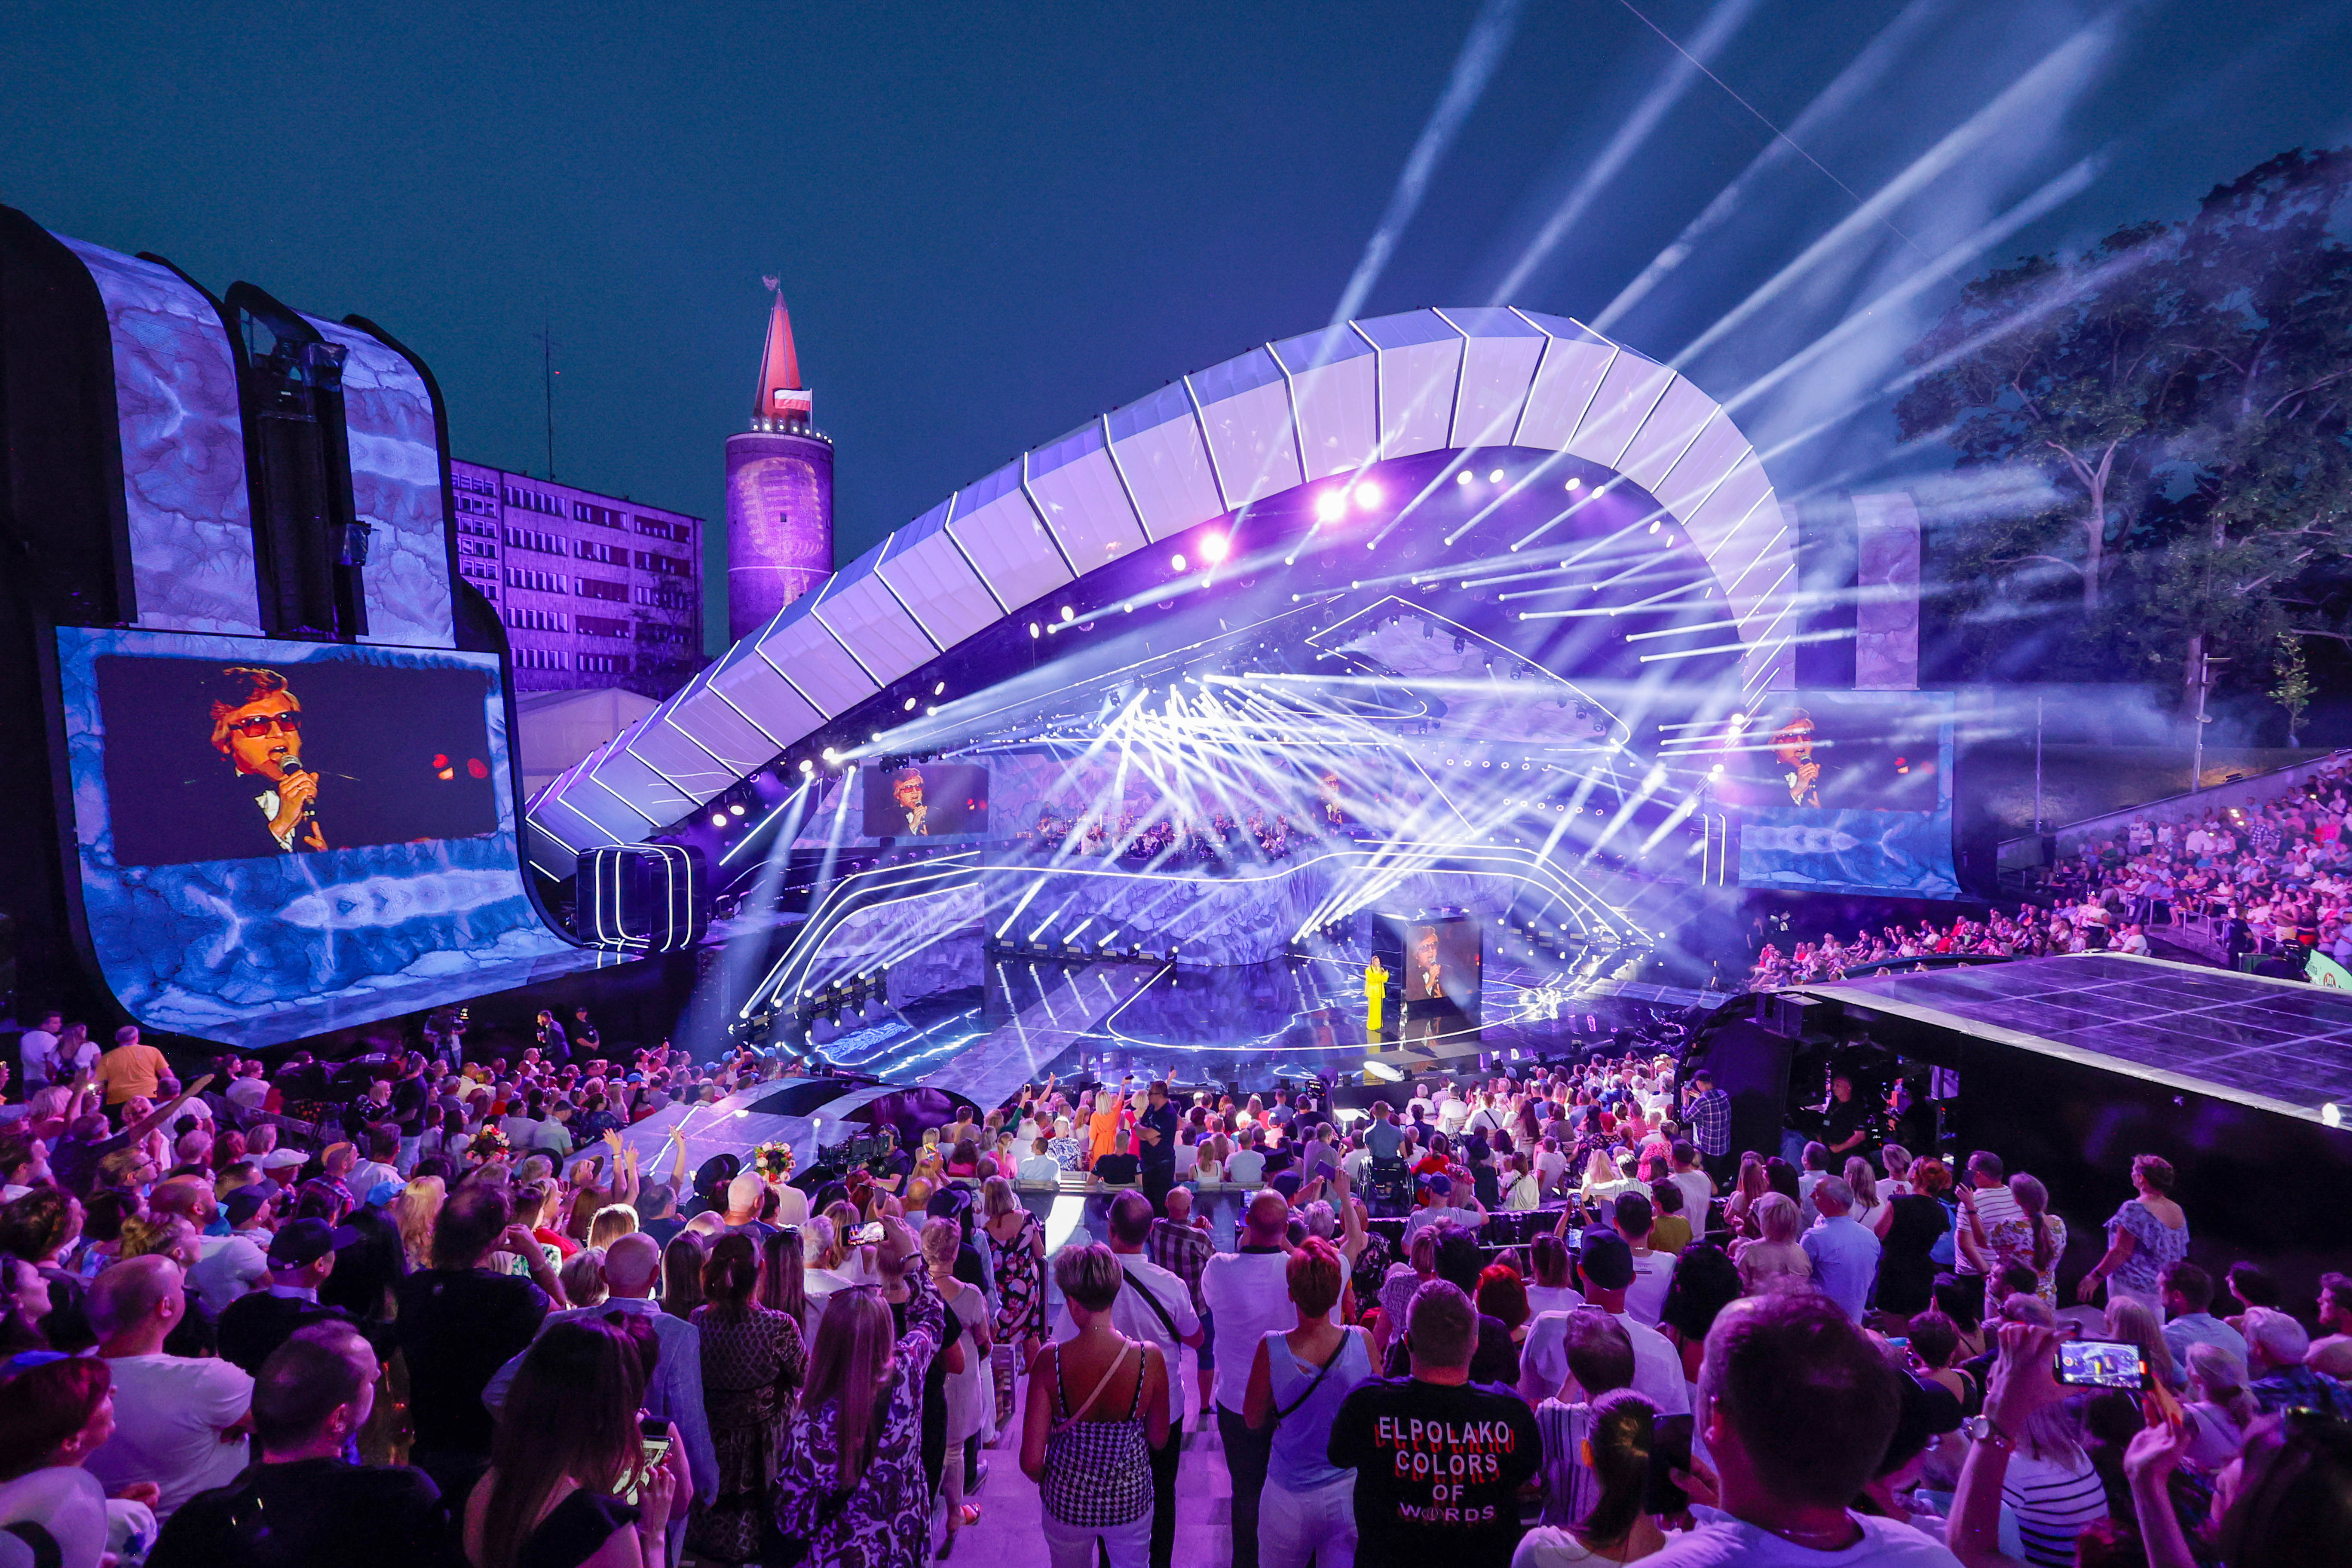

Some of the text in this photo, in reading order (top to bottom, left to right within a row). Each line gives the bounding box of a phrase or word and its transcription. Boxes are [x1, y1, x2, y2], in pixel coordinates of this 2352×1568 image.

[1379, 1417, 1510, 1444] ELPOLAKO
[1396, 1450, 1498, 1475] COLORS
[1433, 1484, 1464, 1501] OF
